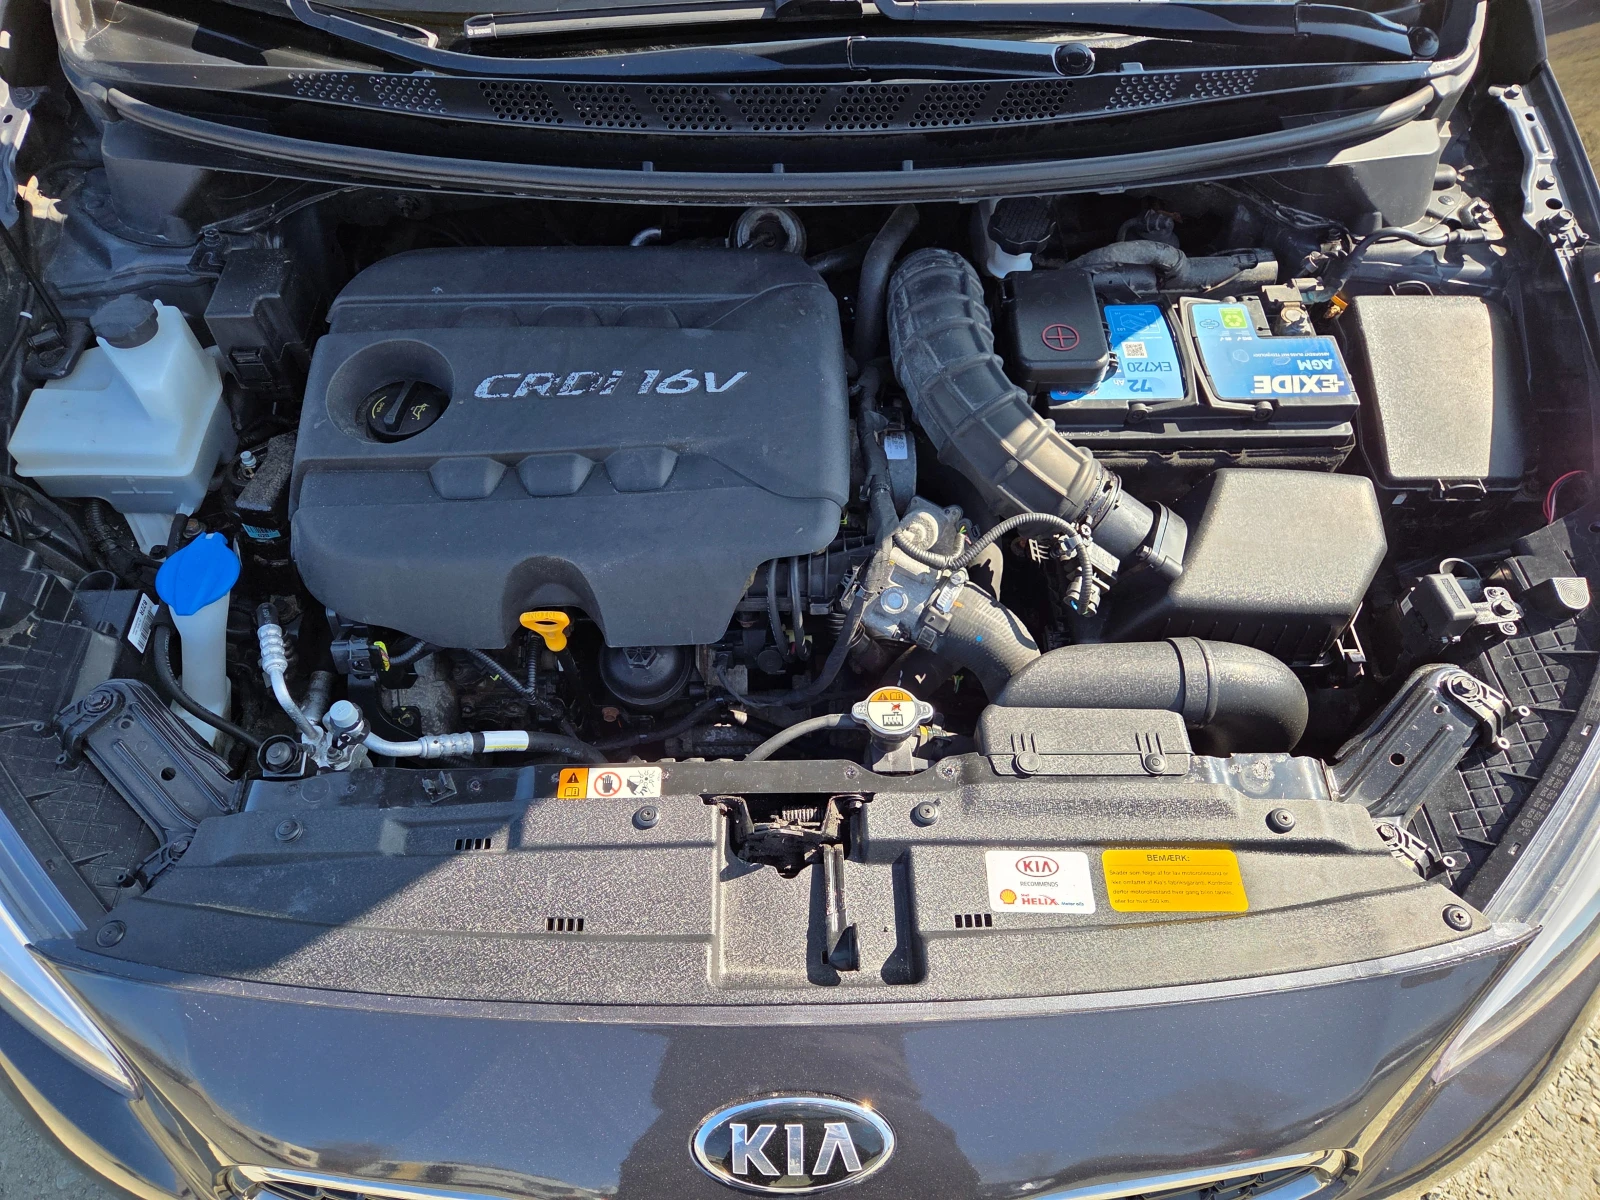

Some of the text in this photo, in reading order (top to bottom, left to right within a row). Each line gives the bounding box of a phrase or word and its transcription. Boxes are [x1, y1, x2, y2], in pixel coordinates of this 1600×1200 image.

[1127, 362, 1172, 372] EK720
[1297, 359, 1334, 370] AGM
[474, 368, 748, 398] CRDi 16V
[1127, 379, 1152, 392] 72
[1251, 374, 1344, 394] EXIDE
[1022, 860, 1052, 872] KIA
[1021, 897, 1058, 906] HELIX
[729, 1122, 863, 1176] KIA
